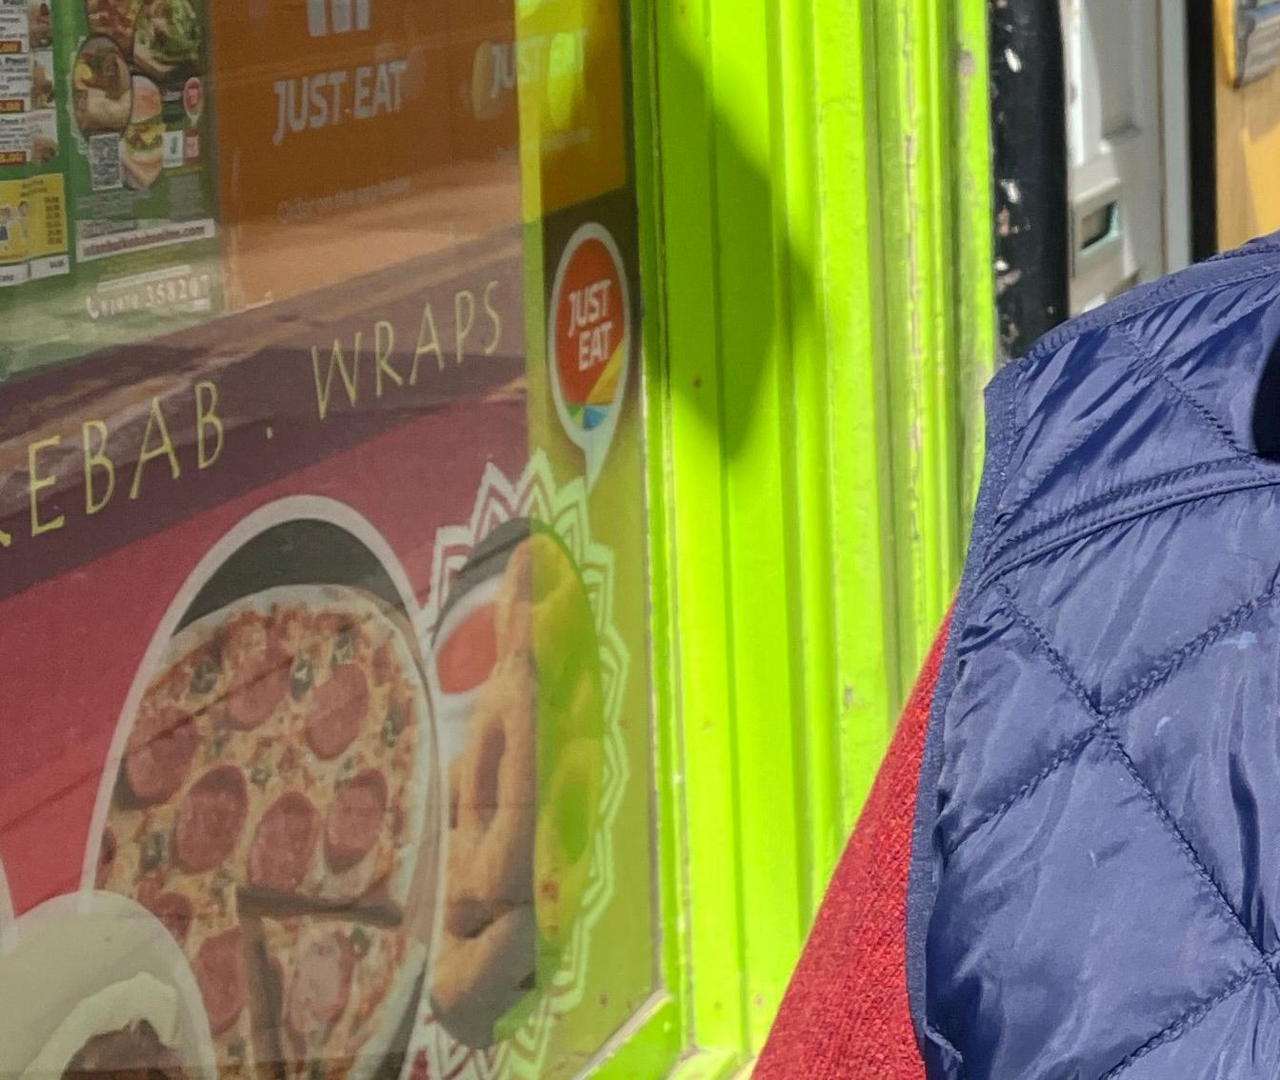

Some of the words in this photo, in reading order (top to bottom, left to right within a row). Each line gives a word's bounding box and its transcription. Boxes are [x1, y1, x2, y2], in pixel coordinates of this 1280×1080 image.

[272, 71, 347, 148] JUST
[353, 59, 410, 121] EAT
[567, 278, 612, 339] JUST
[578, 321, 613, 373] EAT
[0, 380, 225, 550] EBAB
[310, 281, 502, 422] WRAPS
